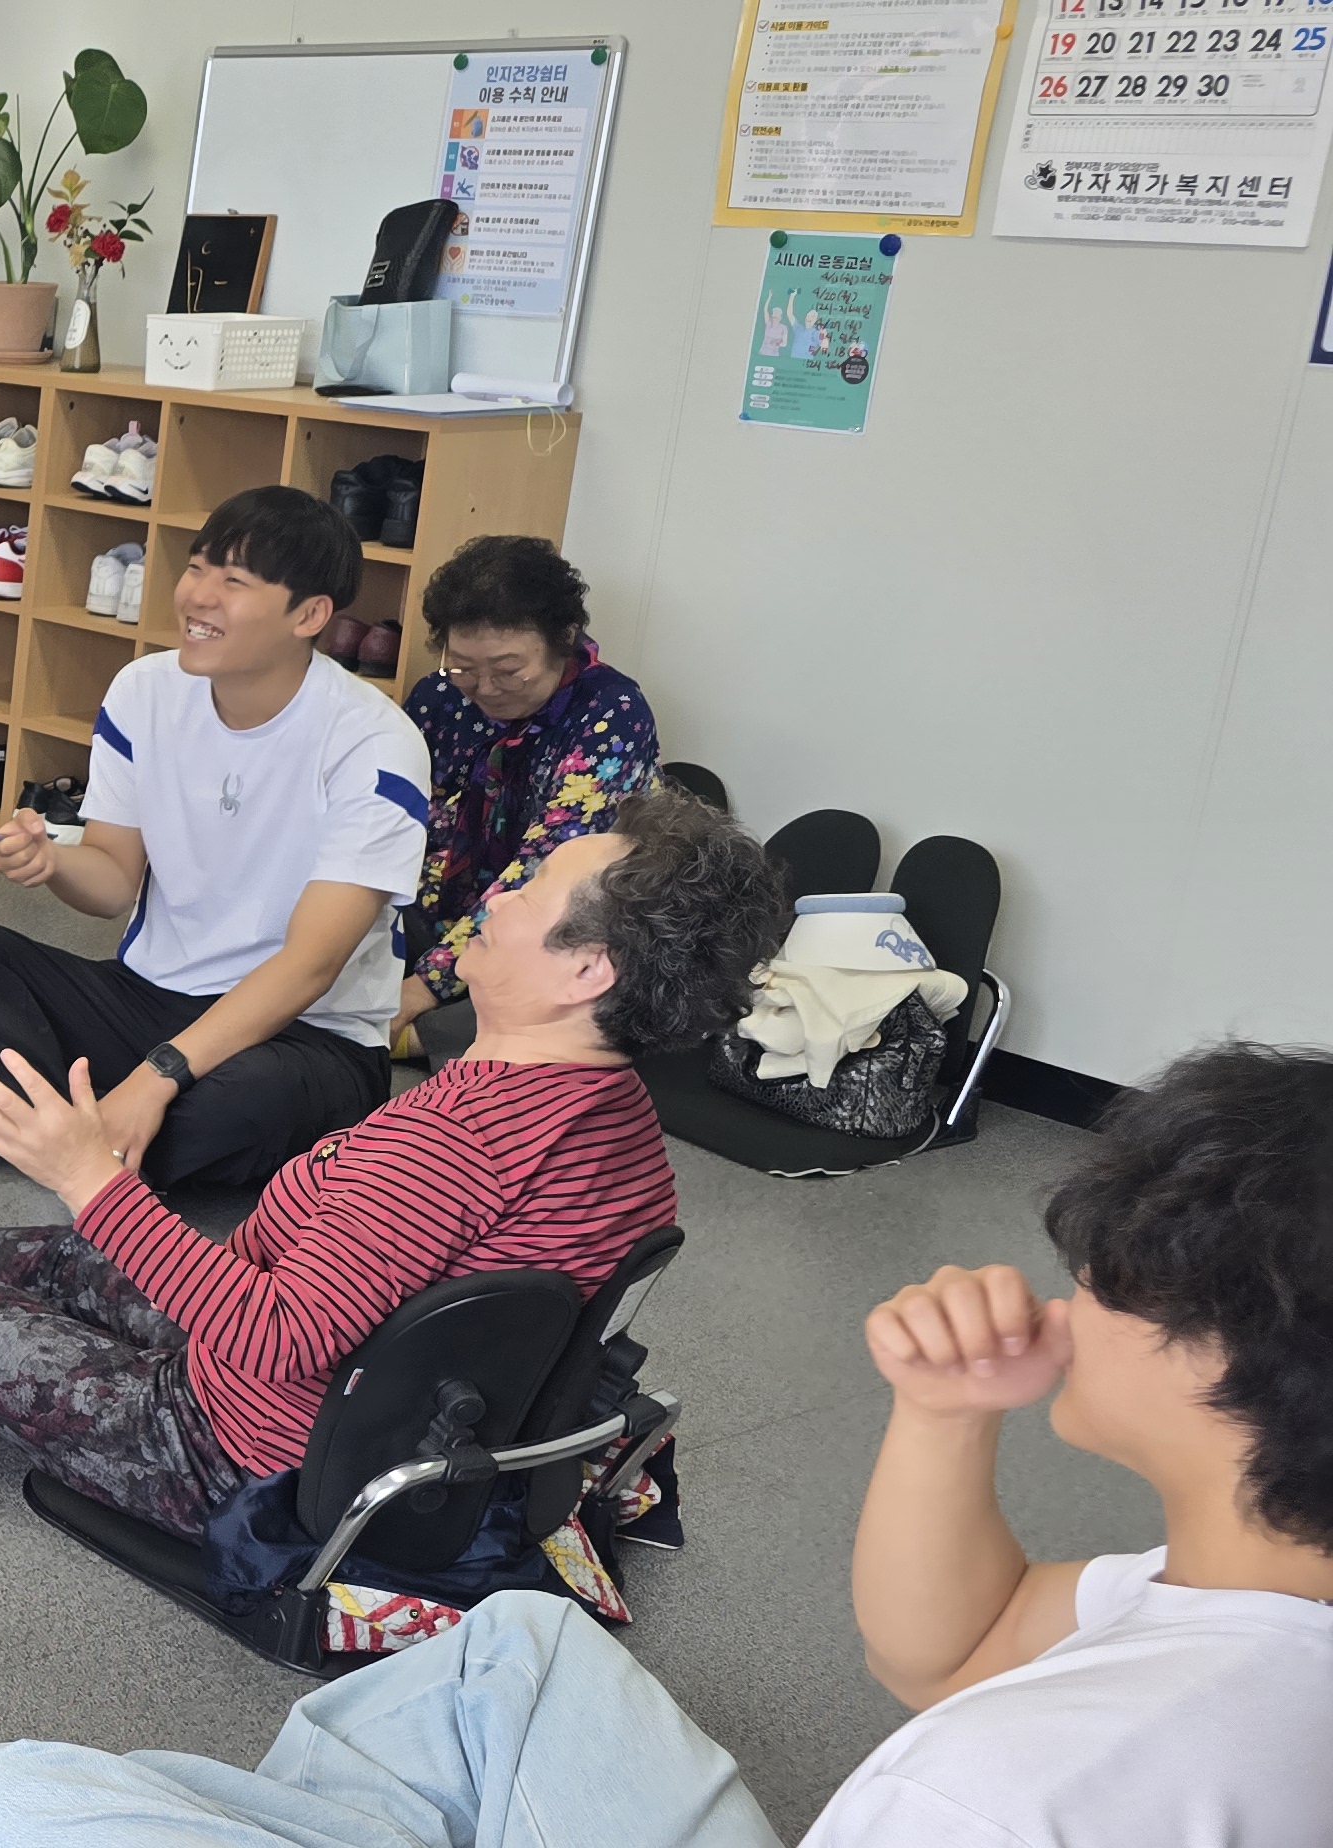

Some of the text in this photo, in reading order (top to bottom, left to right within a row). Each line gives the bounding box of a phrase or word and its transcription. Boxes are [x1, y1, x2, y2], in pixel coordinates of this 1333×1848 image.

[1050, 27, 1327, 55] 19 20 21 22 23 24 25
[485, 64, 569, 83] 인지건강쉼터
[479, 86, 569, 104] 이용 수칙 안내
[1038, 76, 1068, 98] 26
[1075, 74, 1109, 98] 27
[1115, 75, 1147, 98] 28
[1155, 74, 1188, 98] 29
[1197, 74, 1230, 97] 30
[1059, 172, 1293, 199] 가자재가복지센터
[774, 252, 873, 271] 시니어 운동교실
